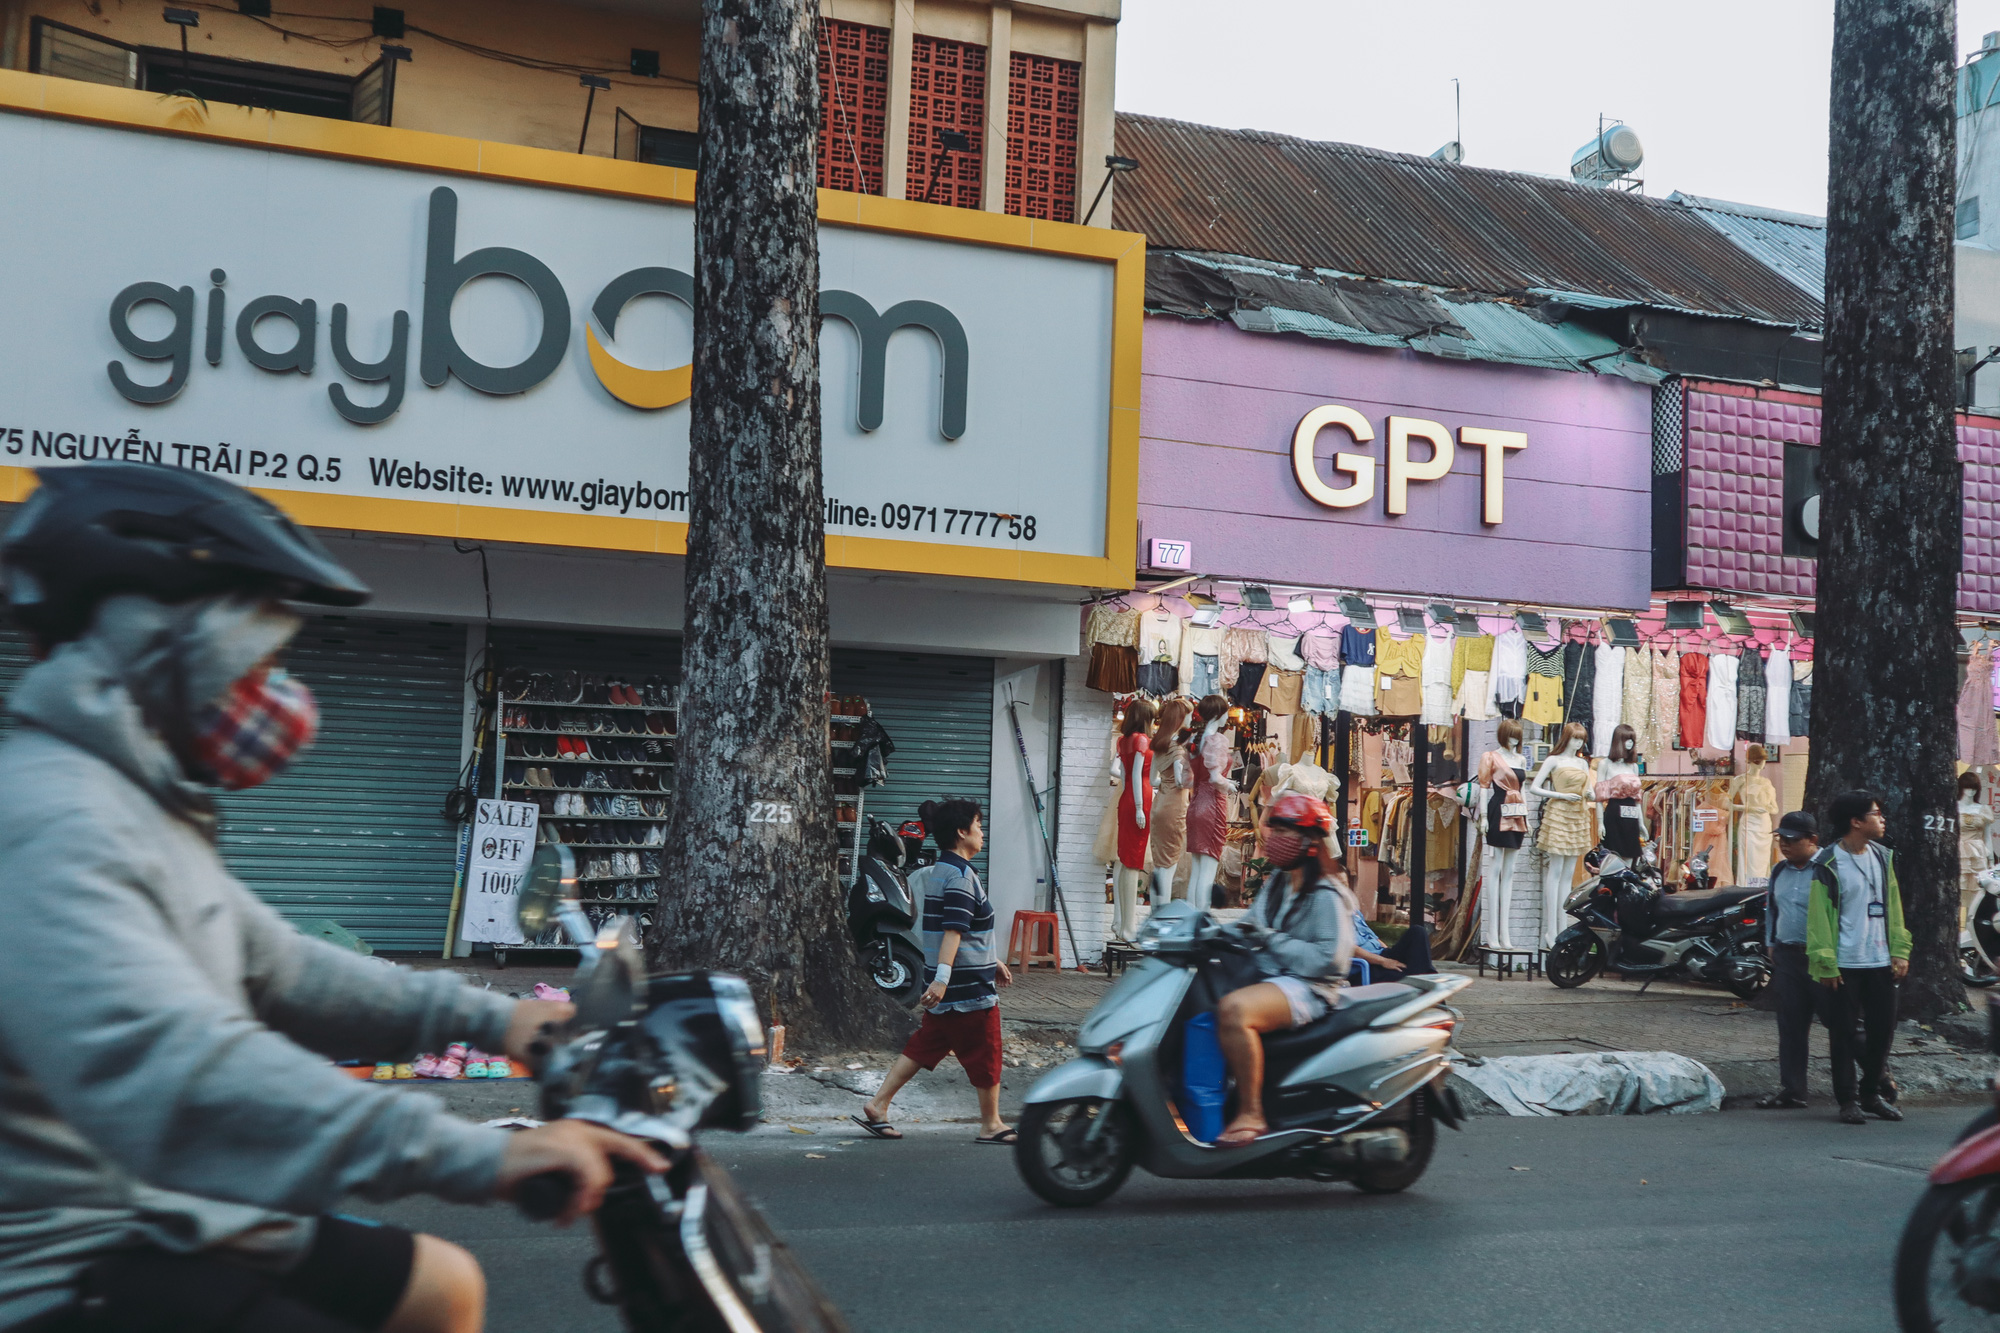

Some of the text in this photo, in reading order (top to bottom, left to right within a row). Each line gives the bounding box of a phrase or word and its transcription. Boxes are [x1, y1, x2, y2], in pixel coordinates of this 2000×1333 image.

[31, 429, 163, 464] NGUYỄN
[171, 443, 242, 474] TRÃI
[248, 450, 288, 479] P.2
[297, 454, 342, 482] Q.5
[1290, 404, 1528, 525] GPT
[369, 457, 493, 495] Website:
[1158, 543, 1185, 564] 77
[478, 802, 535, 828] SALE
[750, 801, 793, 824] 225
[1924, 814, 1956, 833] 227
[481, 836, 525, 861] OFF
[479, 871, 523, 896] 100K
